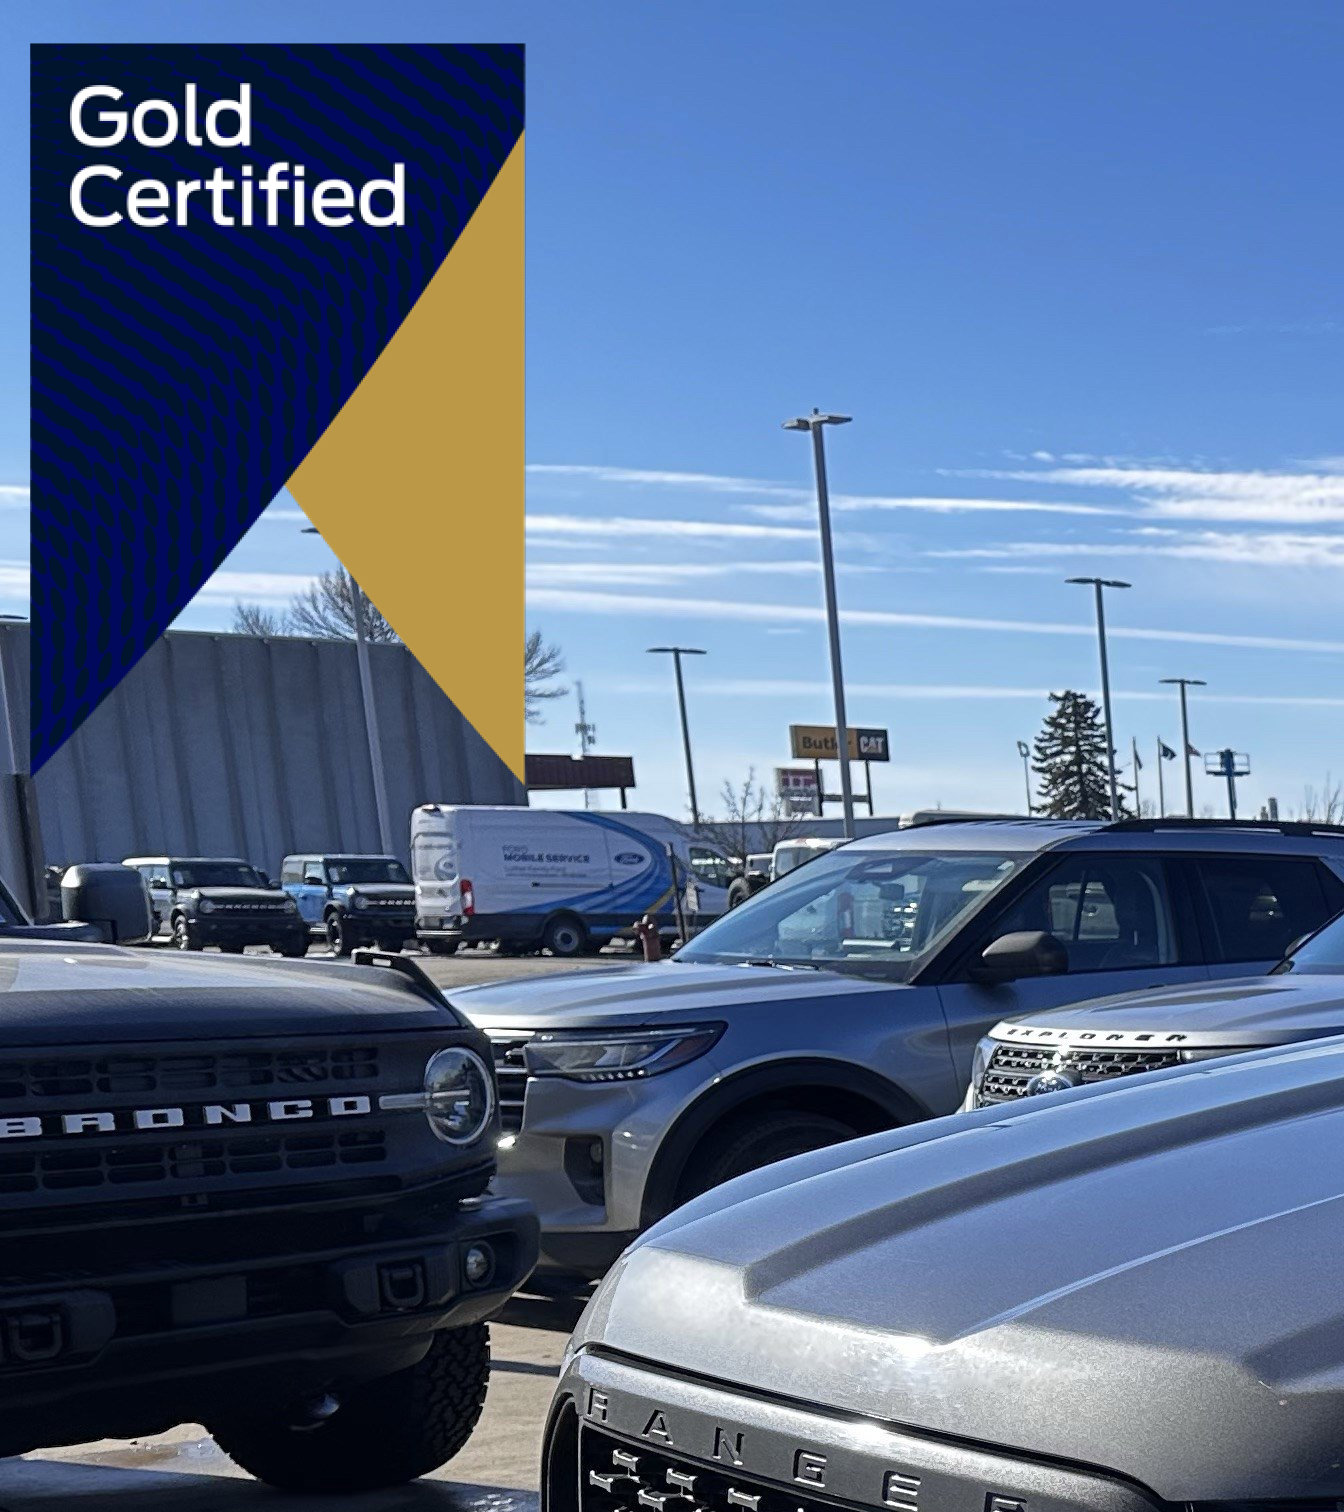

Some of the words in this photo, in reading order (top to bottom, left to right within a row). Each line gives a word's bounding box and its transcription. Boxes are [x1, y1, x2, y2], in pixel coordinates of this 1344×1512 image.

[802, 736, 851, 750] Butl
[860, 736, 884, 753] CAT
[503, 853, 544, 862] MOBILE
[545, 853, 590, 863] SERVICE
[1007, 1028, 1188, 1042] EXPLORER
[0, 1096, 371, 1138] BRONCO
